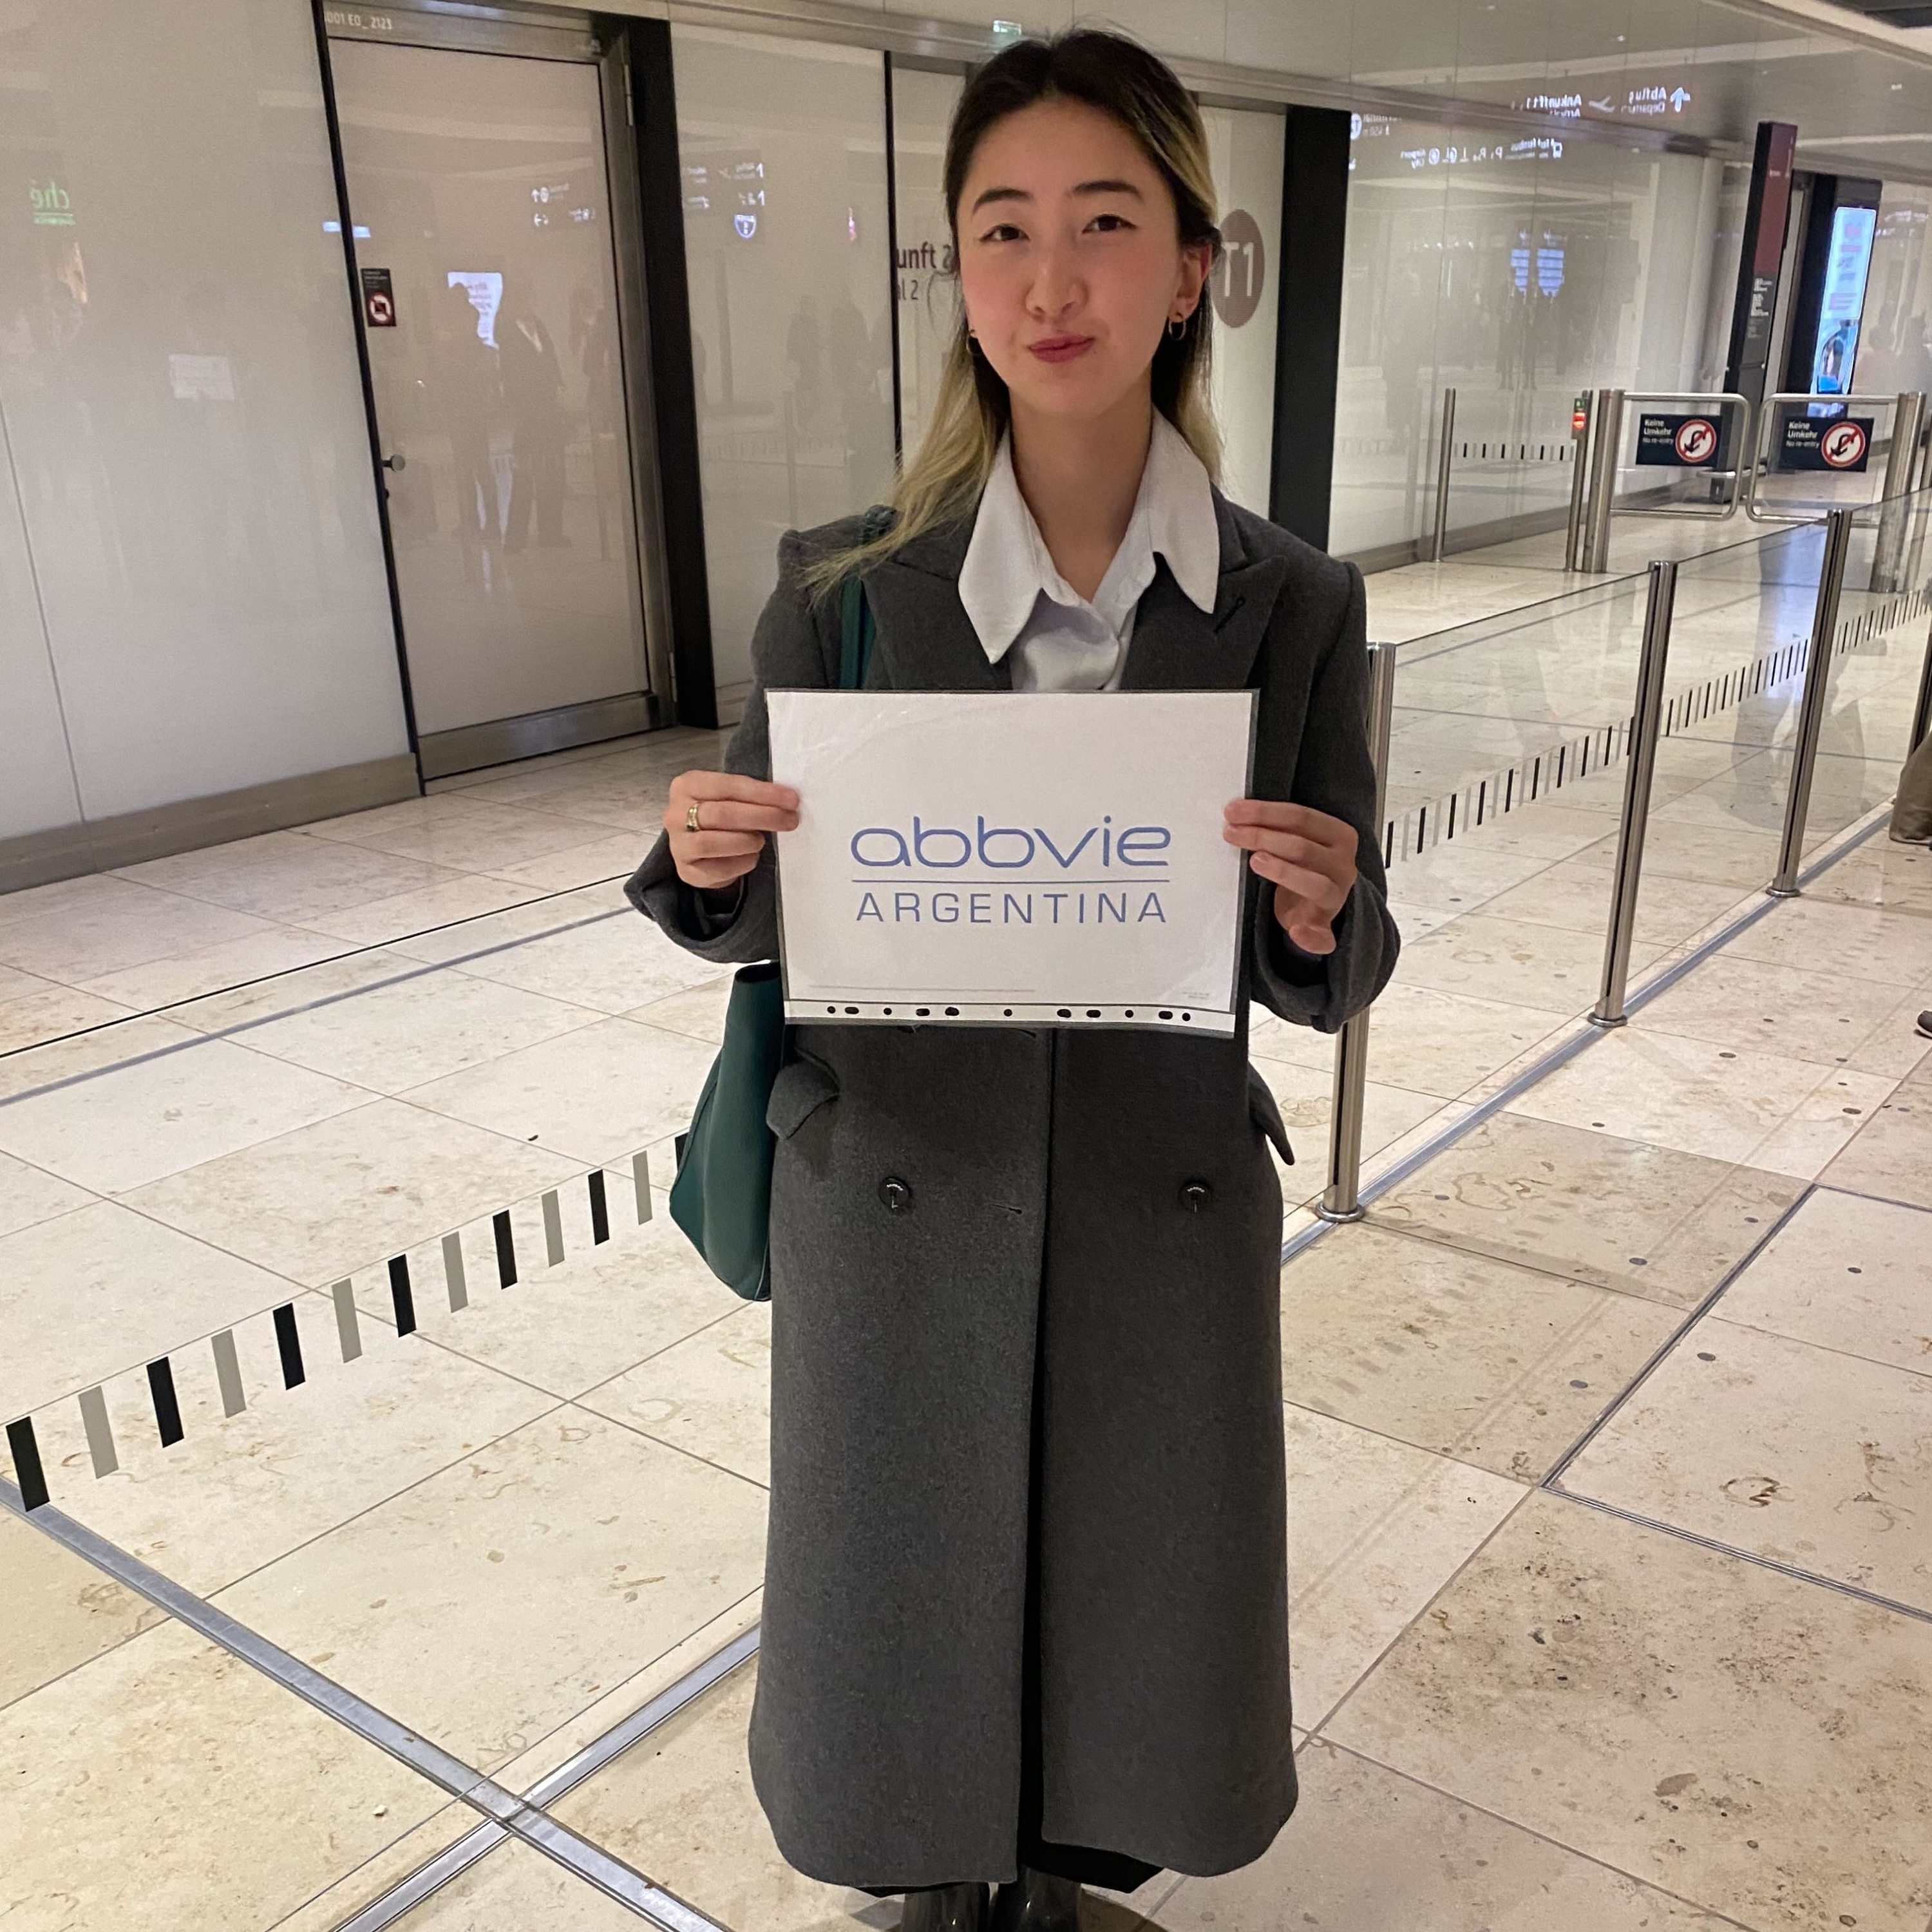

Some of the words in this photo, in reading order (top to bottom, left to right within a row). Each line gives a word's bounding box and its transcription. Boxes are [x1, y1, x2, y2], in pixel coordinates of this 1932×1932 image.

[1222, 241, 1254, 297] T1
[911, 279, 918, 300] 2
[1644, 419, 1665, 427] Keine
[1788, 421, 1810, 430] Keine
[1643, 427, 1672, 435] Umkehr
[1788, 430, 1818, 439] Umkehr
[851, 815, 1171, 868] abbvie
[856, 892, 1167, 923] ARGENTINA
